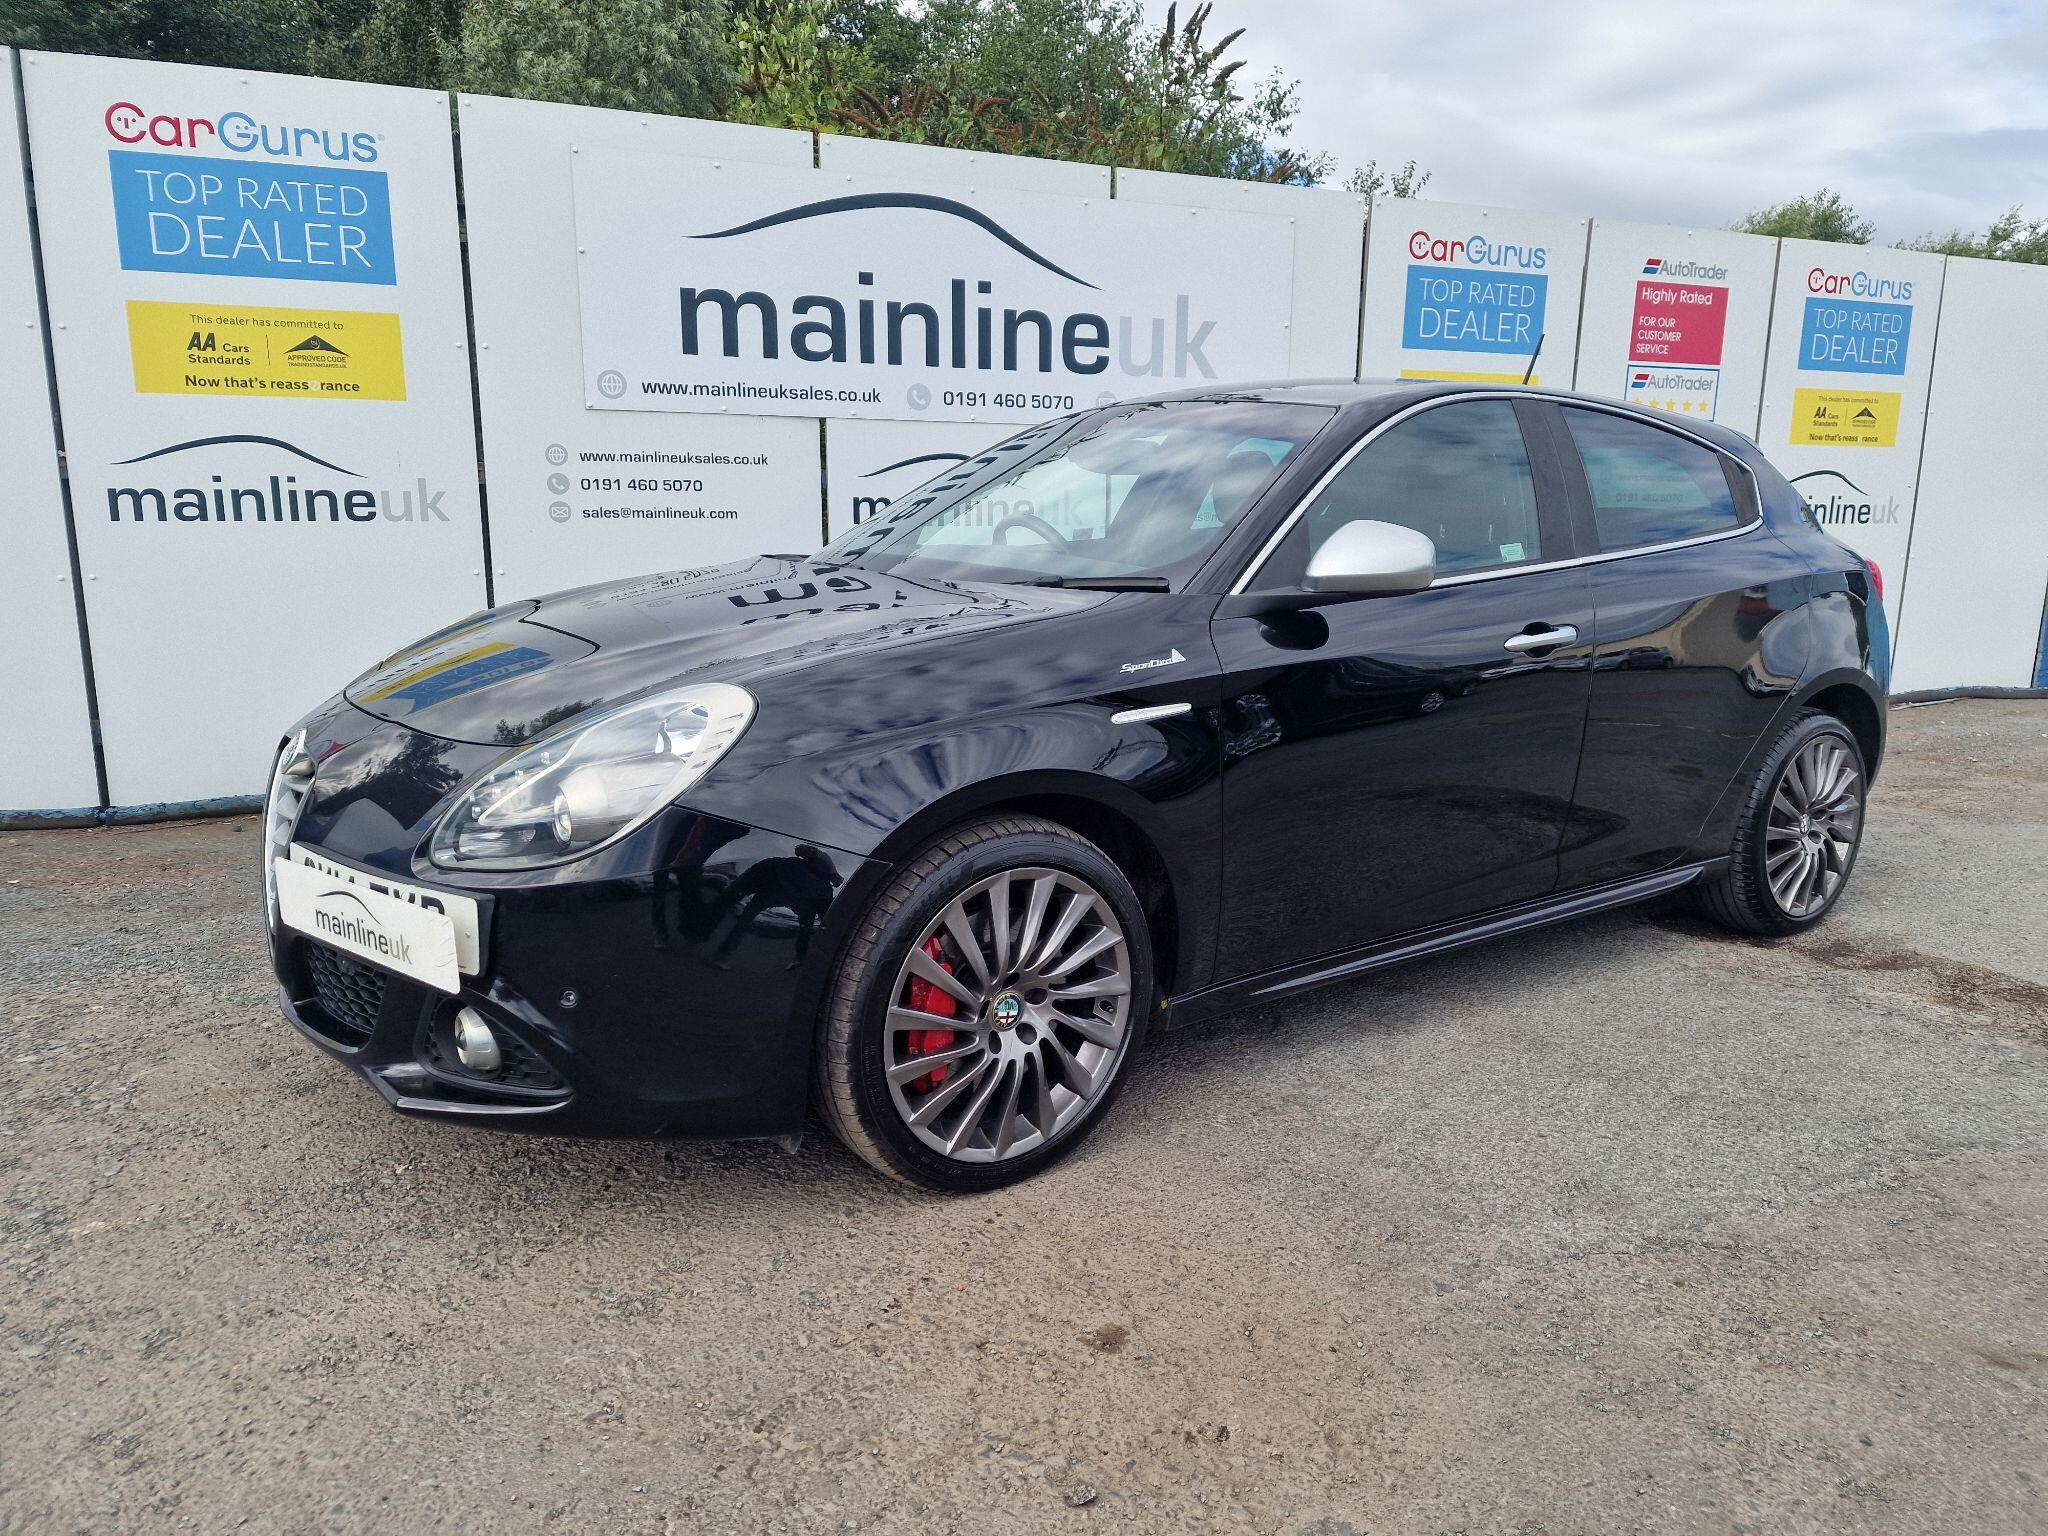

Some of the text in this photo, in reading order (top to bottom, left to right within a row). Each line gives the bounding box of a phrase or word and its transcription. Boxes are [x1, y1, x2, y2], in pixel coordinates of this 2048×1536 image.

[105, 102, 377, 162] CarGurus
[135, 169, 368, 217] TOP RATED
[148, 211, 372, 268] DEALER
[1409, 230, 1546, 269] CarGurus
[1660, 260, 1728, 281] AutoTrader
[1419, 277, 1536, 308] TOP RATED
[1808, 267, 1912, 300] CarGurus
[1641, 288, 1713, 305] Highly Rated
[190, 314, 344, 330] This dealer has committed to
[679, 271, 1219, 380] mainlineuk
[1419, 307, 1531, 344] DEALER
[1638, 316, 1676, 328] FOR OUR
[1814, 308, 1903, 334] TOP RATED
[187, 331, 250, 353] AA Cars
[1638, 330, 1681, 342] CUSTOMER
[287, 354, 346, 363] APPROVED CODE
[1636, 343, 1669, 355] SERVICE
[1811, 334, 1898, 365] DEALER
[188, 353, 251, 366] Standards
[185, 375, 360, 392] Now that's reassrance
[641, 380, 882, 405] www.mainlineuksales.co.uk
[1646, 374, 1714, 391] AutoTrader
[943, 391, 1074, 410] 0191 460 5070
[1814, 406, 1827, 418] AA
[1809, 433, 1823, 441] Now
[579, 450, 769, 466] www.mainlineuksales.co.uk
[581, 478, 703, 493] 0191 460 5070
[107, 475, 450, 522] mainlineuk
[582, 507, 738, 520] sales@mainlineuk.com
[315, 908, 413, 965] mainlineuk
